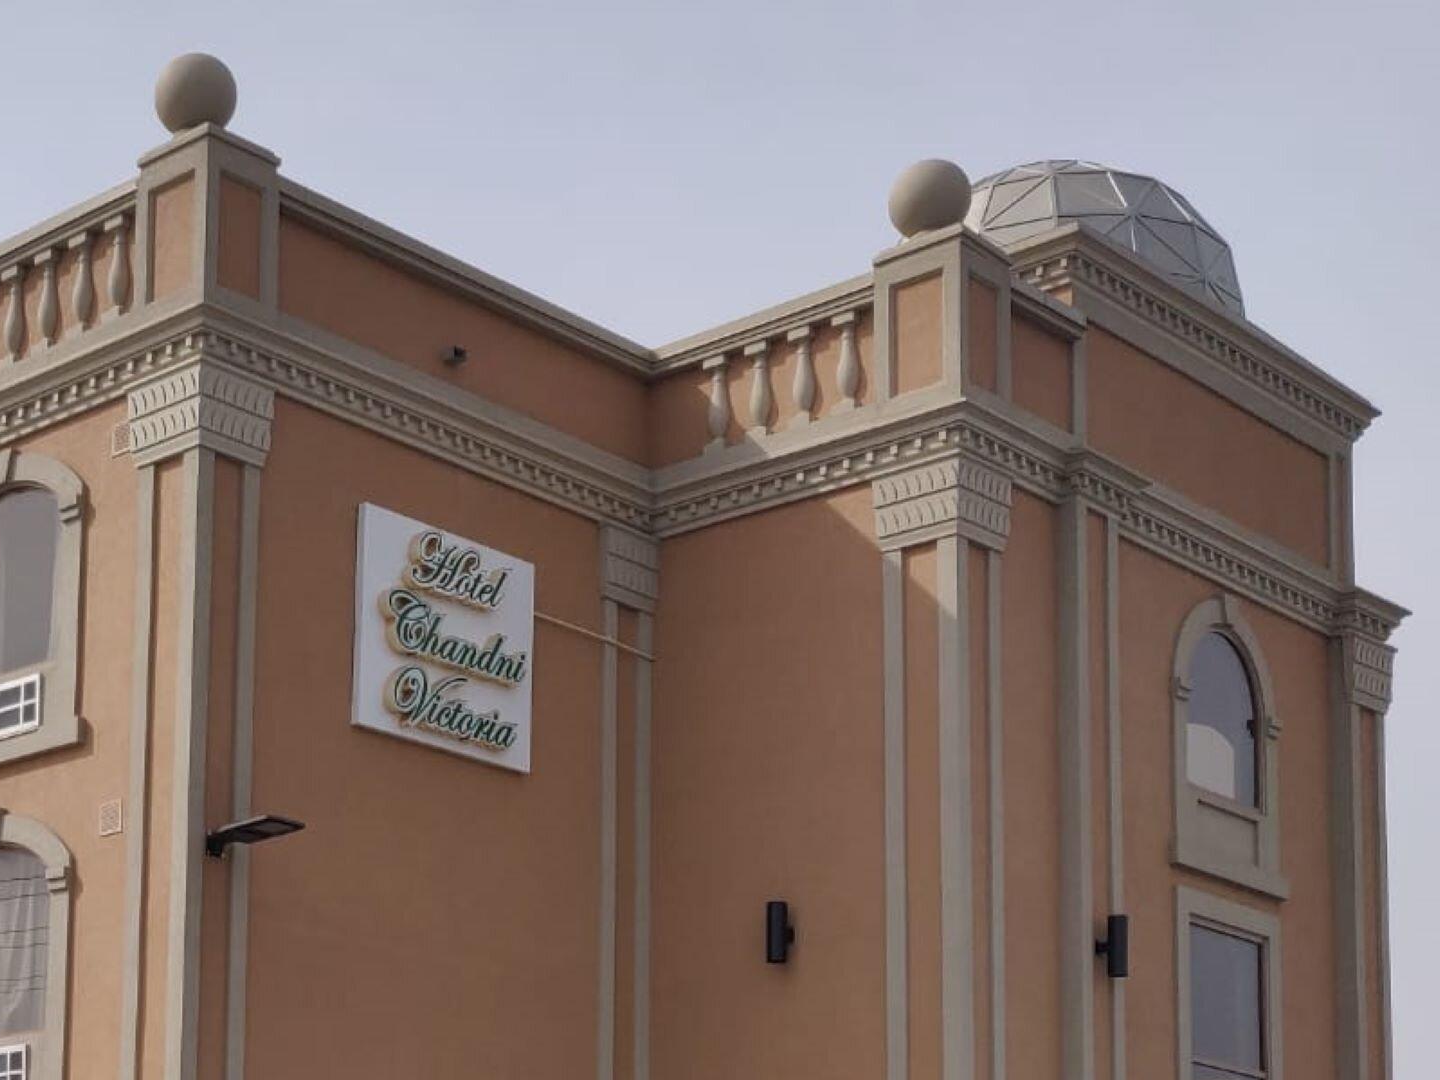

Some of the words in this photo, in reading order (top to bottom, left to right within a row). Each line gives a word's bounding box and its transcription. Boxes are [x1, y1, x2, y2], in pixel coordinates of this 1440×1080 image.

[411, 531, 508, 608] Hotel
[387, 588, 526, 684] Chandni
[392, 665, 516, 749] Victoria
